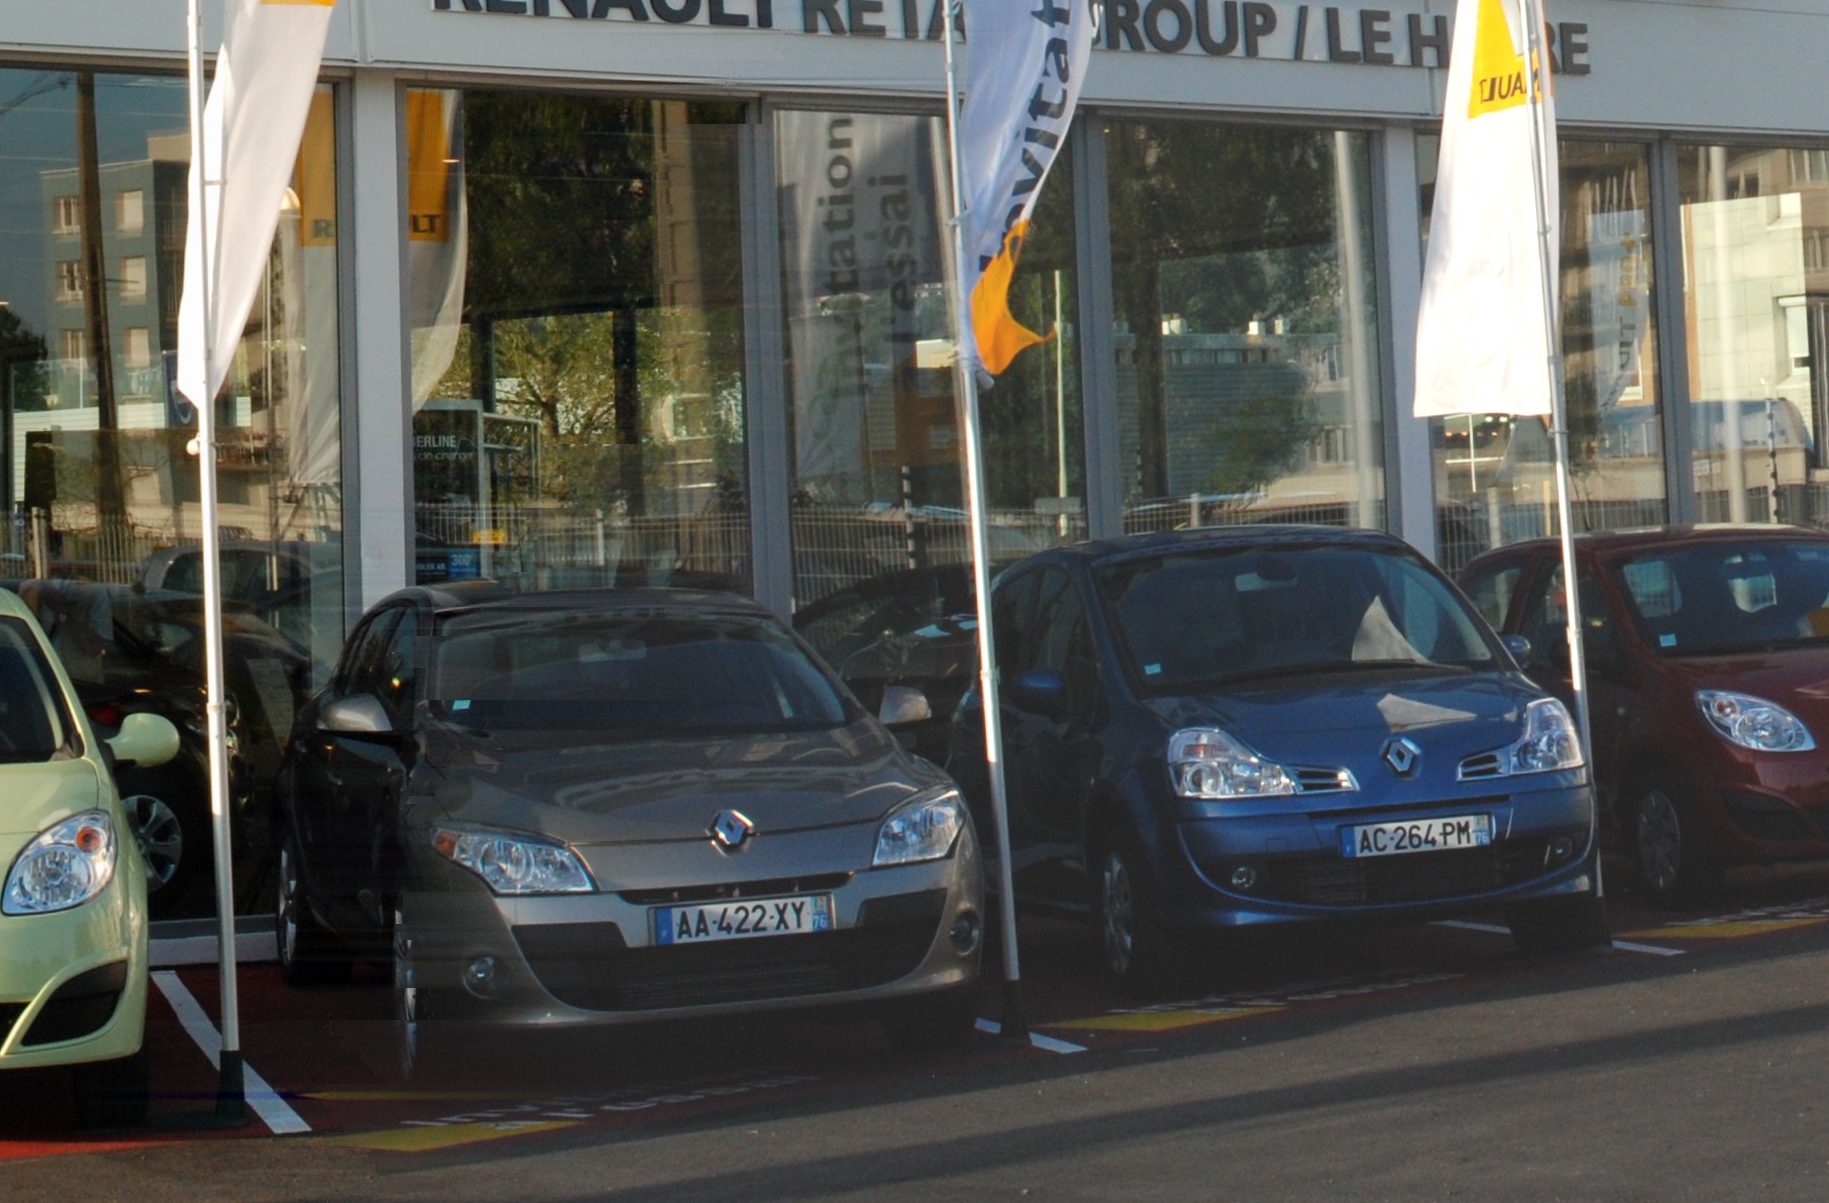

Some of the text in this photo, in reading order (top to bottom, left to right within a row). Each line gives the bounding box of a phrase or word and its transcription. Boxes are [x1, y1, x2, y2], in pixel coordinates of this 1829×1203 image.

[1325, 6, 1394, 65] LE
[1359, 821, 1471, 854] AC-264-PM
[677, 901, 805, 940] AA-422-XY
